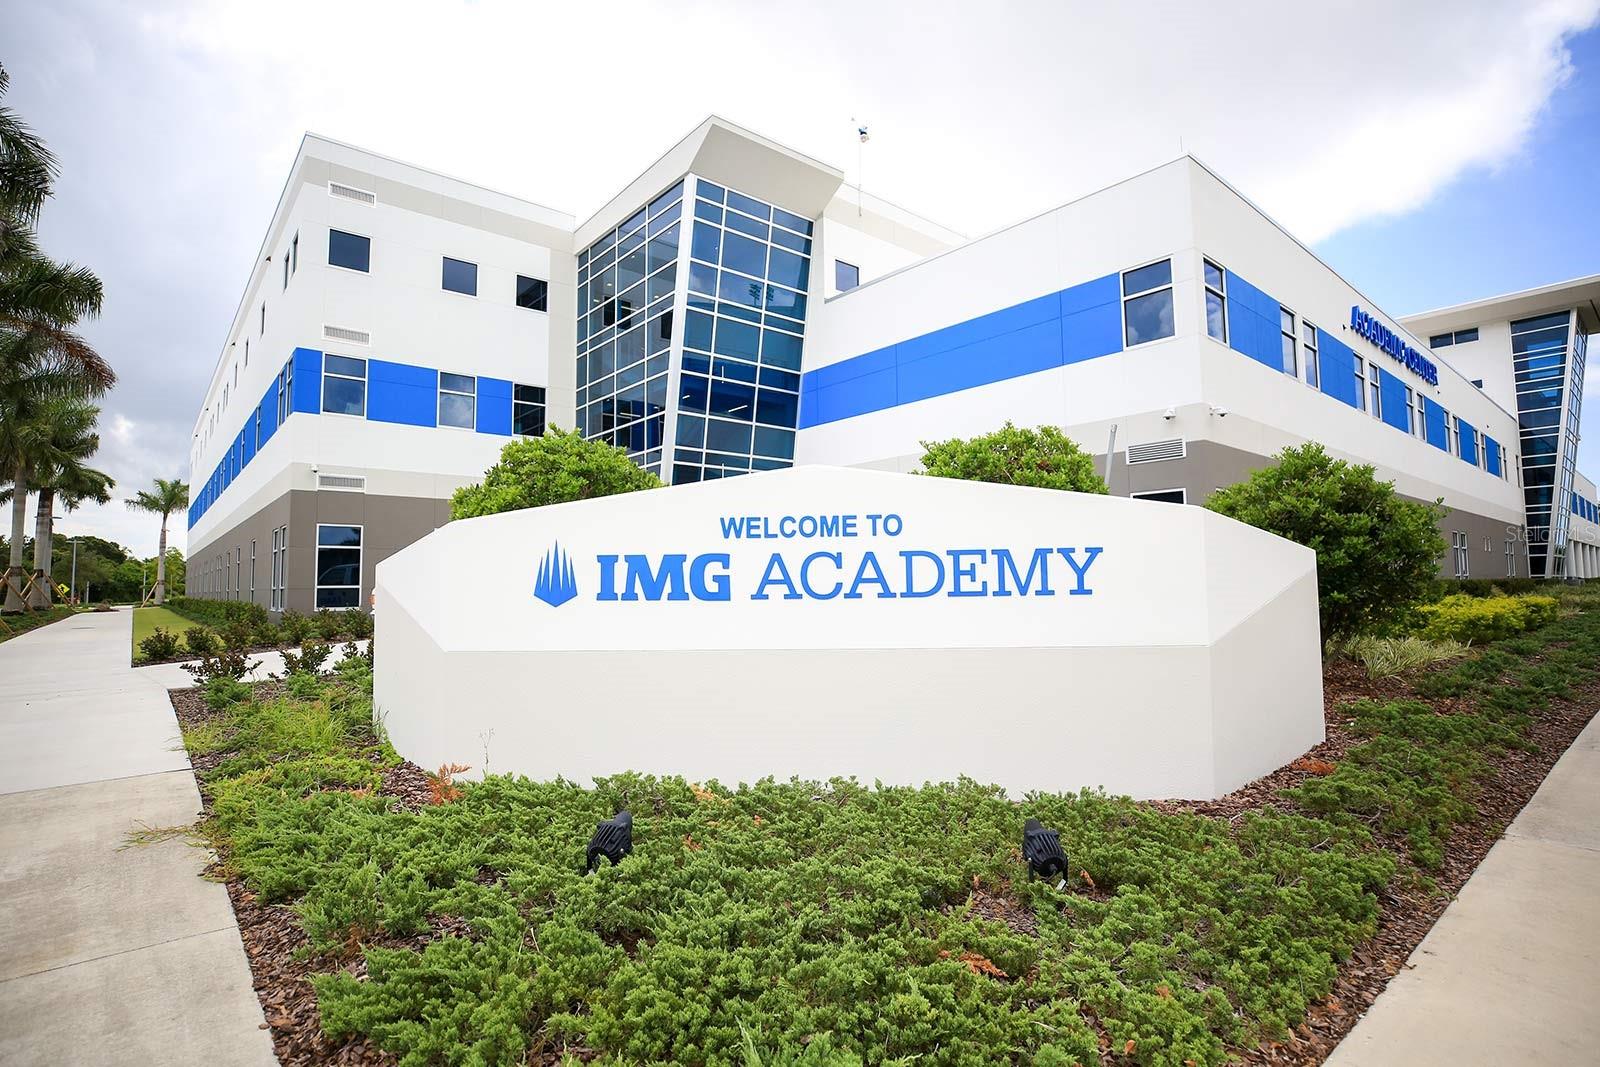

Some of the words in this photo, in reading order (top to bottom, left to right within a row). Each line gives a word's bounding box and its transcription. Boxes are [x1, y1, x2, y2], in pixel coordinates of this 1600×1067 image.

[1351, 305, 1405, 362] ACADEMIC
[1404, 346, 1439, 386] CENTER
[720, 515, 857, 540] WELCOME
[866, 514, 903, 536] TO
[596, 553, 731, 602] IMG
[752, 547, 1103, 601] ACADEMY
